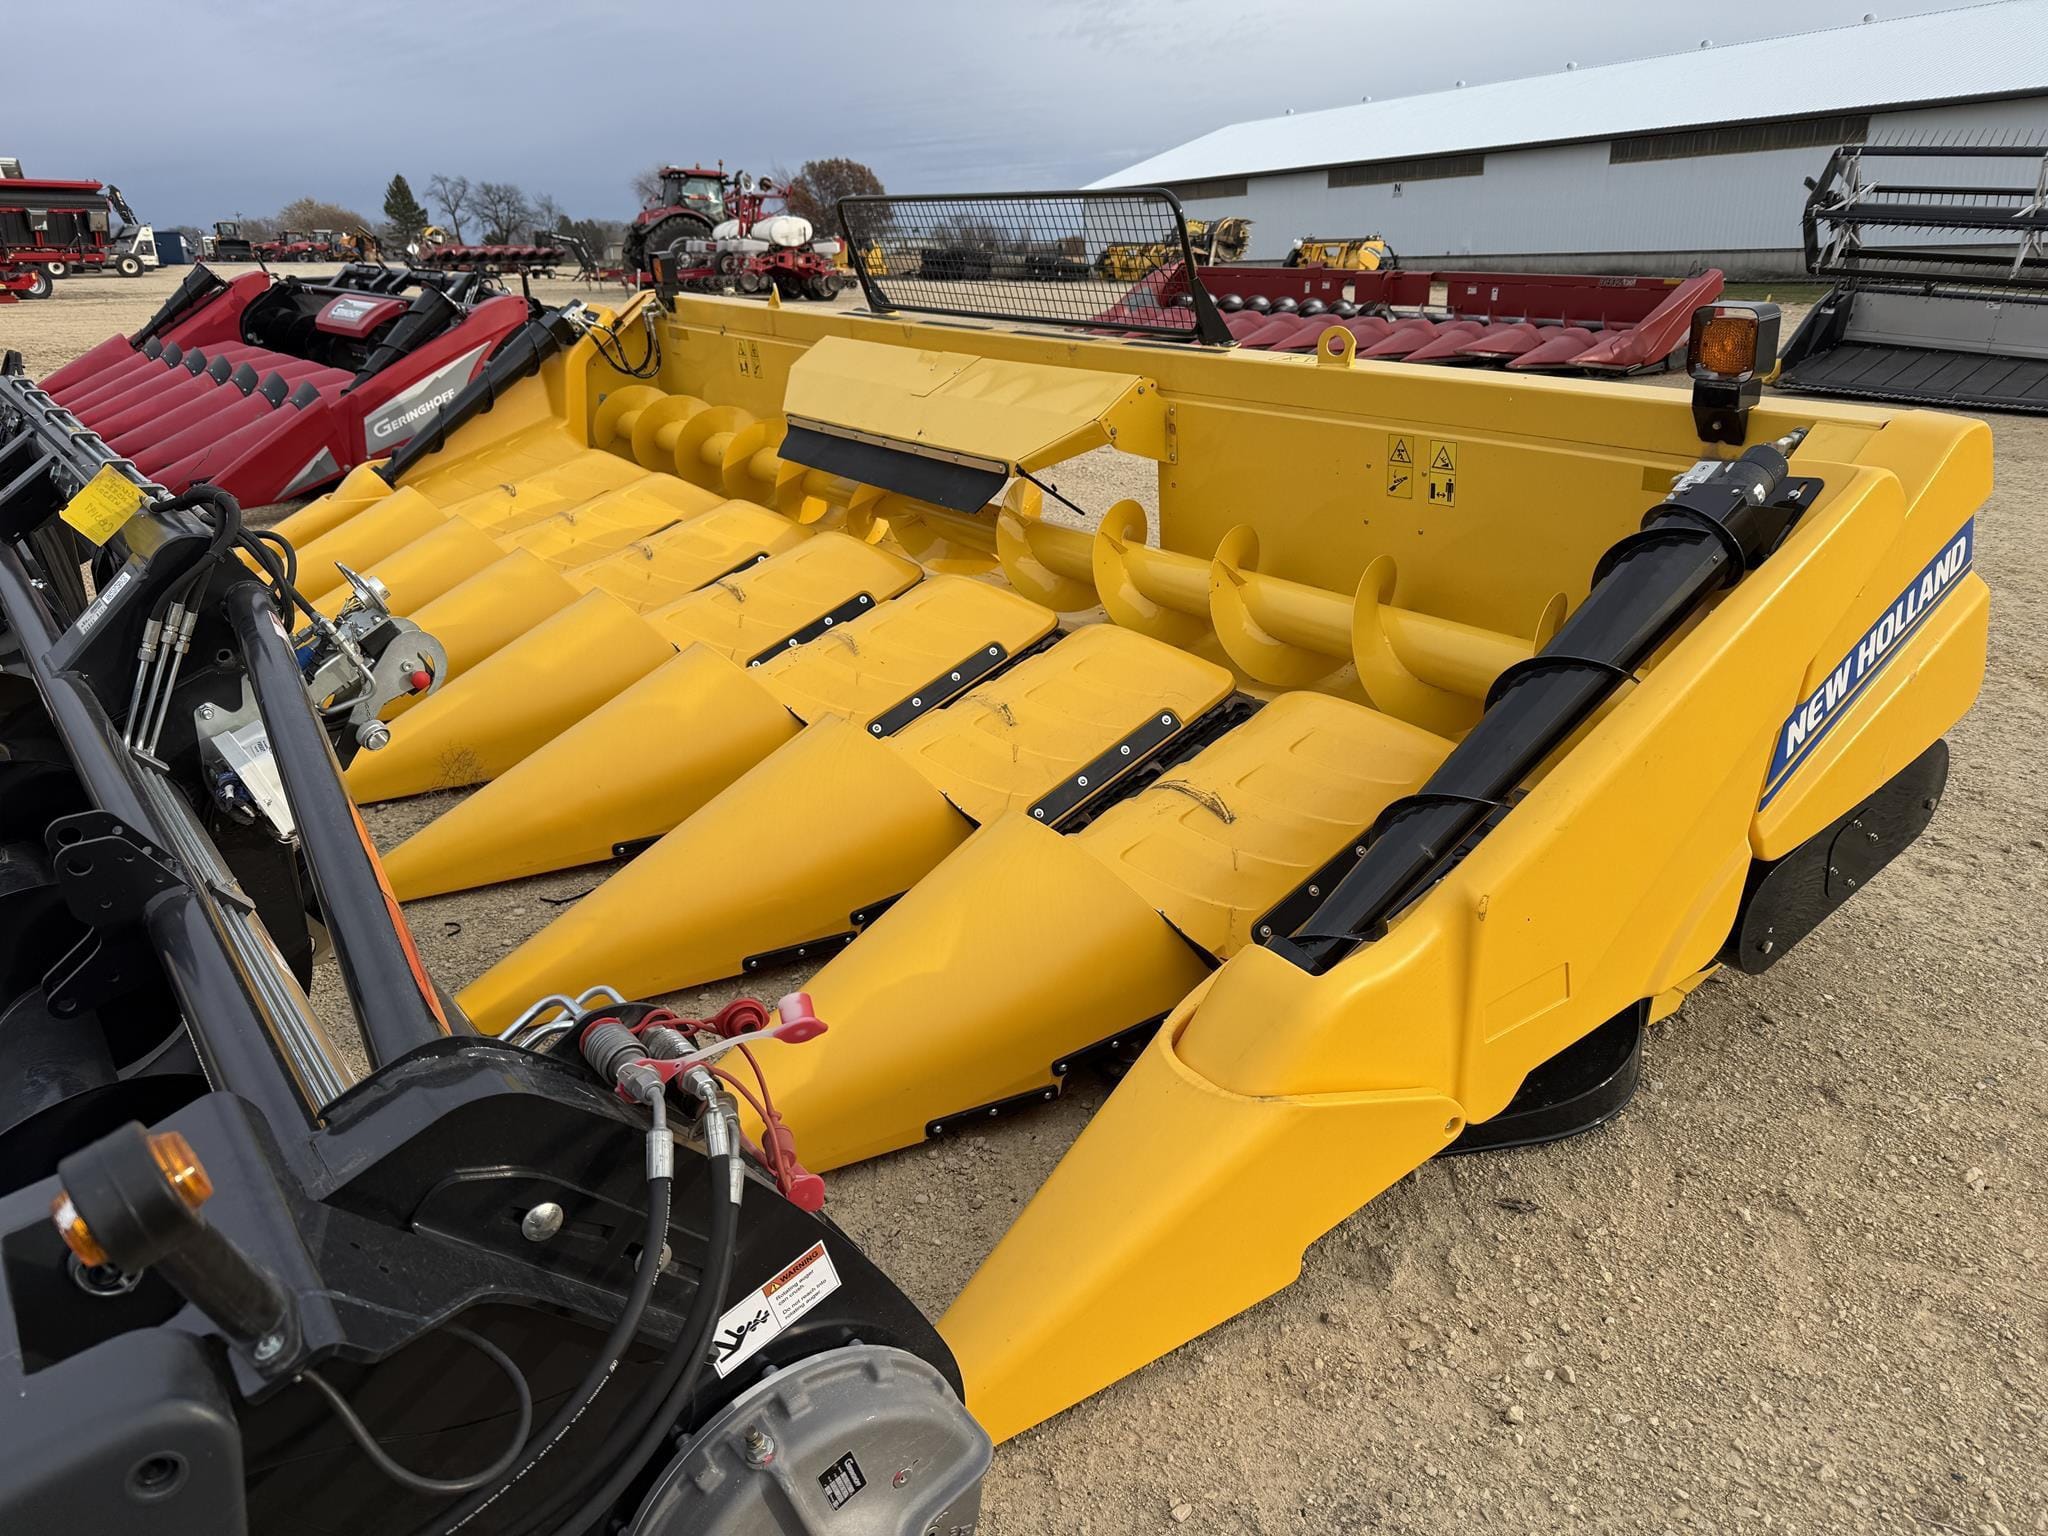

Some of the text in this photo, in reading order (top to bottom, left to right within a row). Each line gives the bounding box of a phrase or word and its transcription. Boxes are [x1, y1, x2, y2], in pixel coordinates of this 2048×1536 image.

[373, 388, 455, 438] GERINGHOFF
[1786, 535, 1966, 759] NEW HOLLAND
[780, 1250, 819, 1283] WARNING
[775, 1269, 814, 1301] Rotating auger
[778, 1295, 789, 1306] can
[782, 1279, 827, 1315] Do not reach into
[785, 1289, 821, 1320] rotating auger
